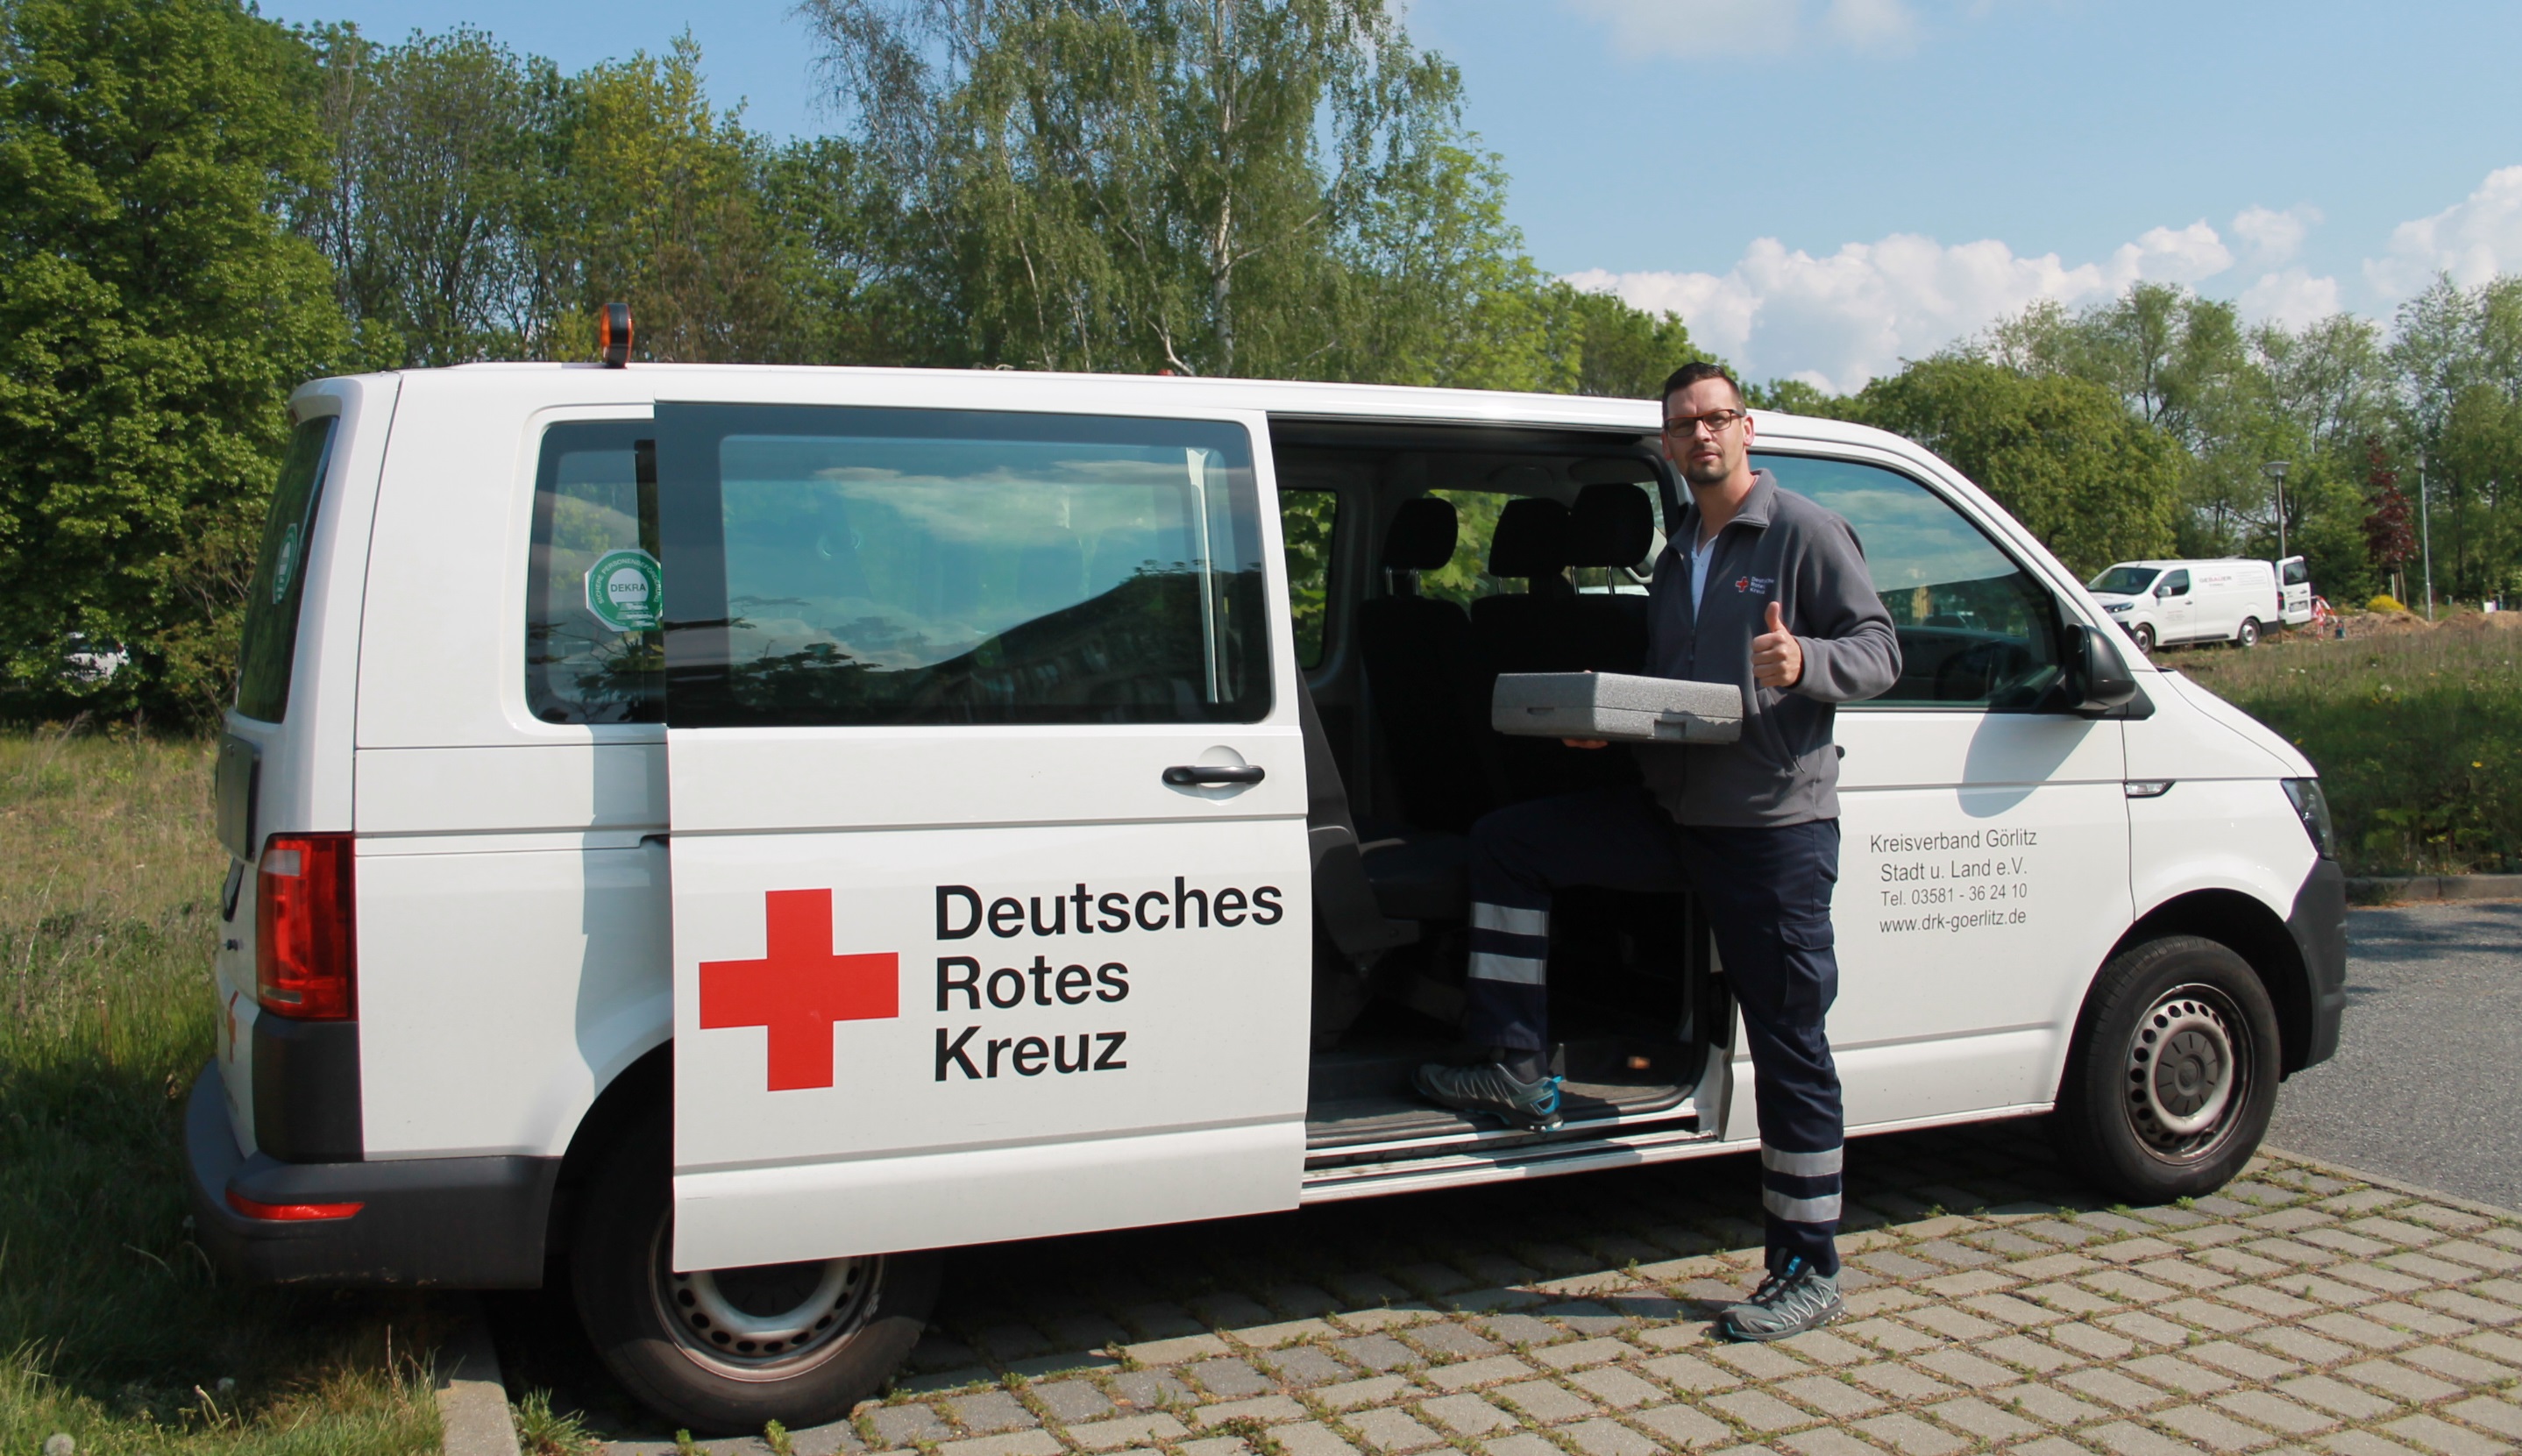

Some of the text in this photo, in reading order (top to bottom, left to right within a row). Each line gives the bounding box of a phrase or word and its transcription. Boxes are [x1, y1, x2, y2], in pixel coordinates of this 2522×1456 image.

[595, 574, 605, 605] SICHERE
[610, 583, 647, 593] DEKRA
[1870, 827, 2037, 854] Kreisverband Görlitz
[1880, 856, 2028, 883] Stadt u. Land e.V.
[1880, 890, 1907, 906] Tel.
[1911, 887, 1953, 906] 03581
[1968, 884, 1986, 902] 36
[1989, 884, 2007, 900] 24
[2011, 883, 2028, 898] 10
[935, 876, 1283, 941] Deutsches
[1879, 907, 2027, 934] www.drk-goerlitz.de
[935, 955, 1129, 1012] Rotes
[934, 1026, 1127, 1082] Kreuz
